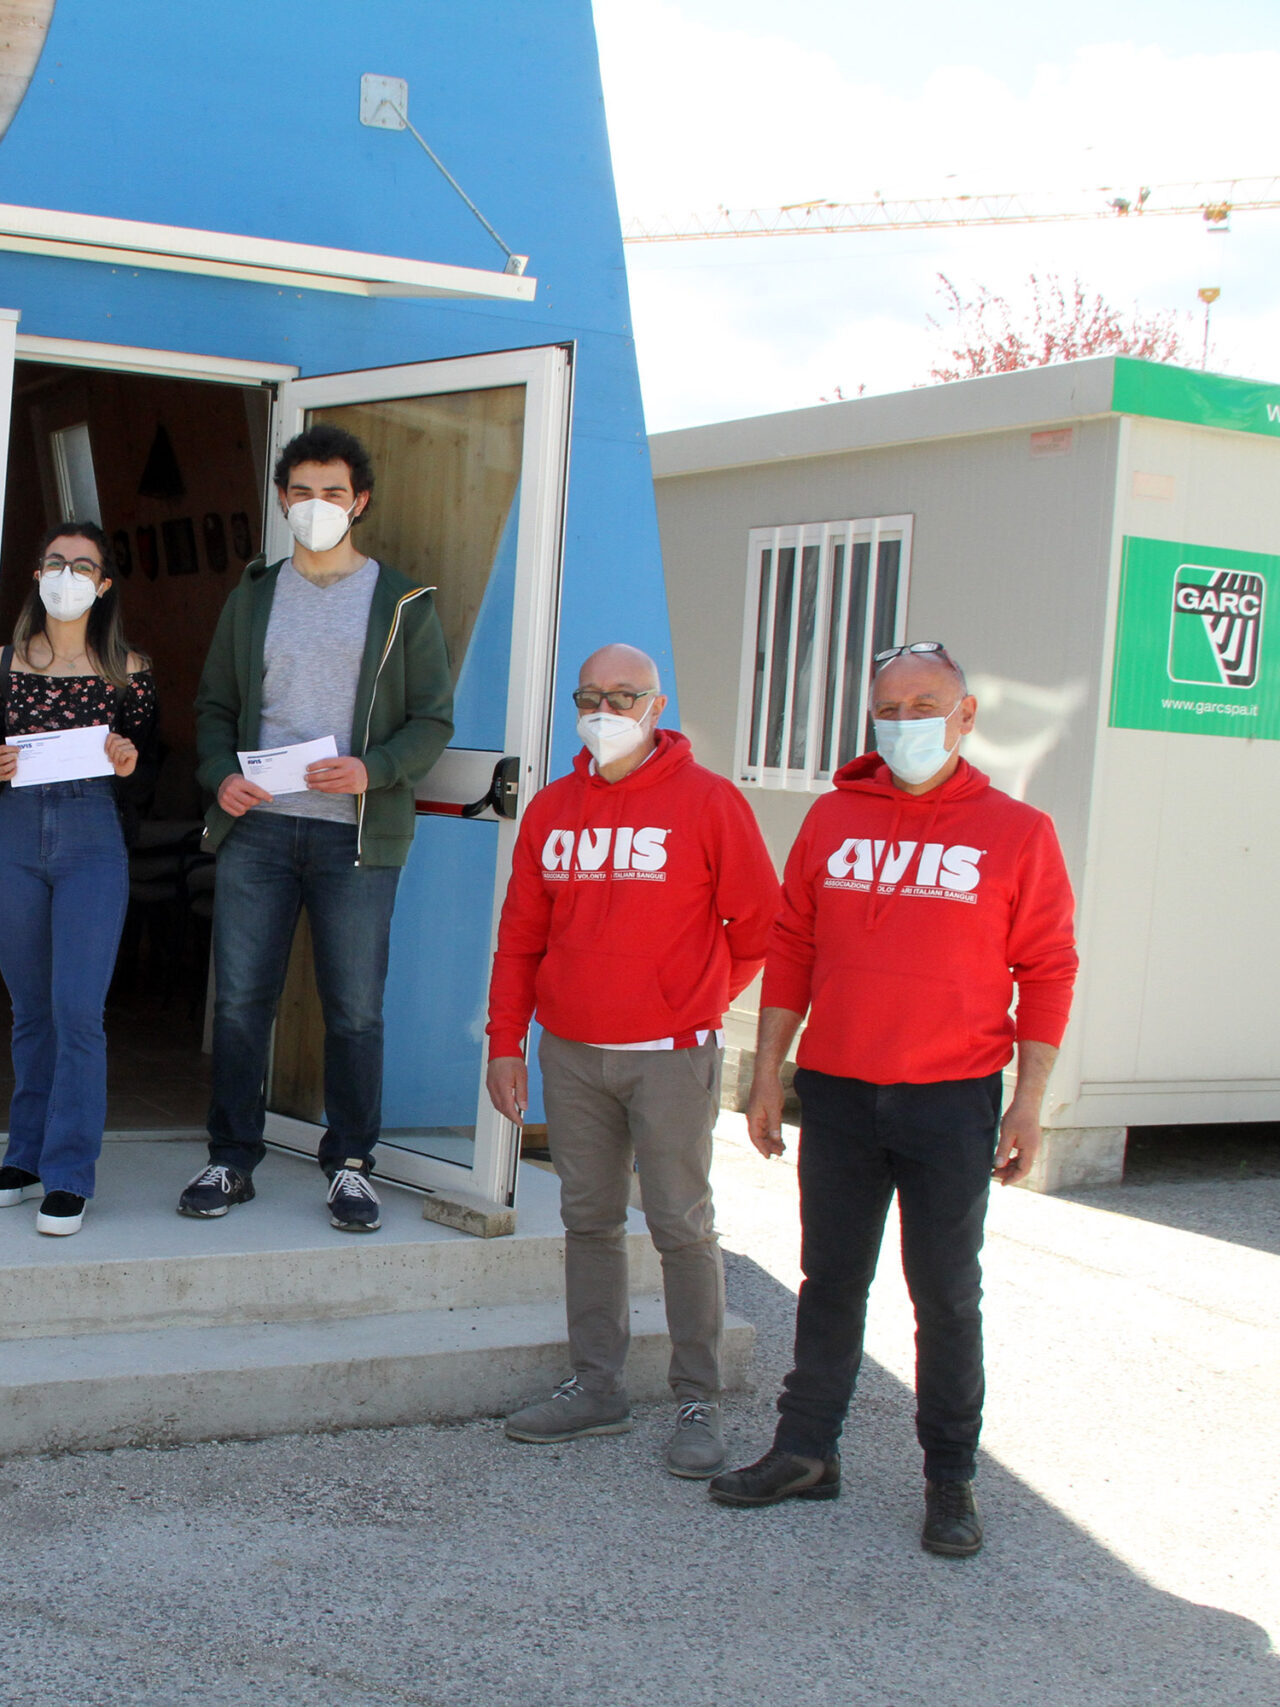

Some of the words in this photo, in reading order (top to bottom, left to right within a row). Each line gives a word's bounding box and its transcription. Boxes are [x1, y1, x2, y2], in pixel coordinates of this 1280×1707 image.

[1176, 587, 1260, 616] GARC
[1161, 698, 1258, 716] www.garcspa.it
[541, 827, 668, 871] AVIS
[637, 872, 665, 881] SANGUE
[827, 838, 981, 892] AVIS
[824, 880, 871, 891] ASSOCIAZIONE
[913, 888, 943, 897] ITALIANI
[943, 891, 975, 902] SANGUE
